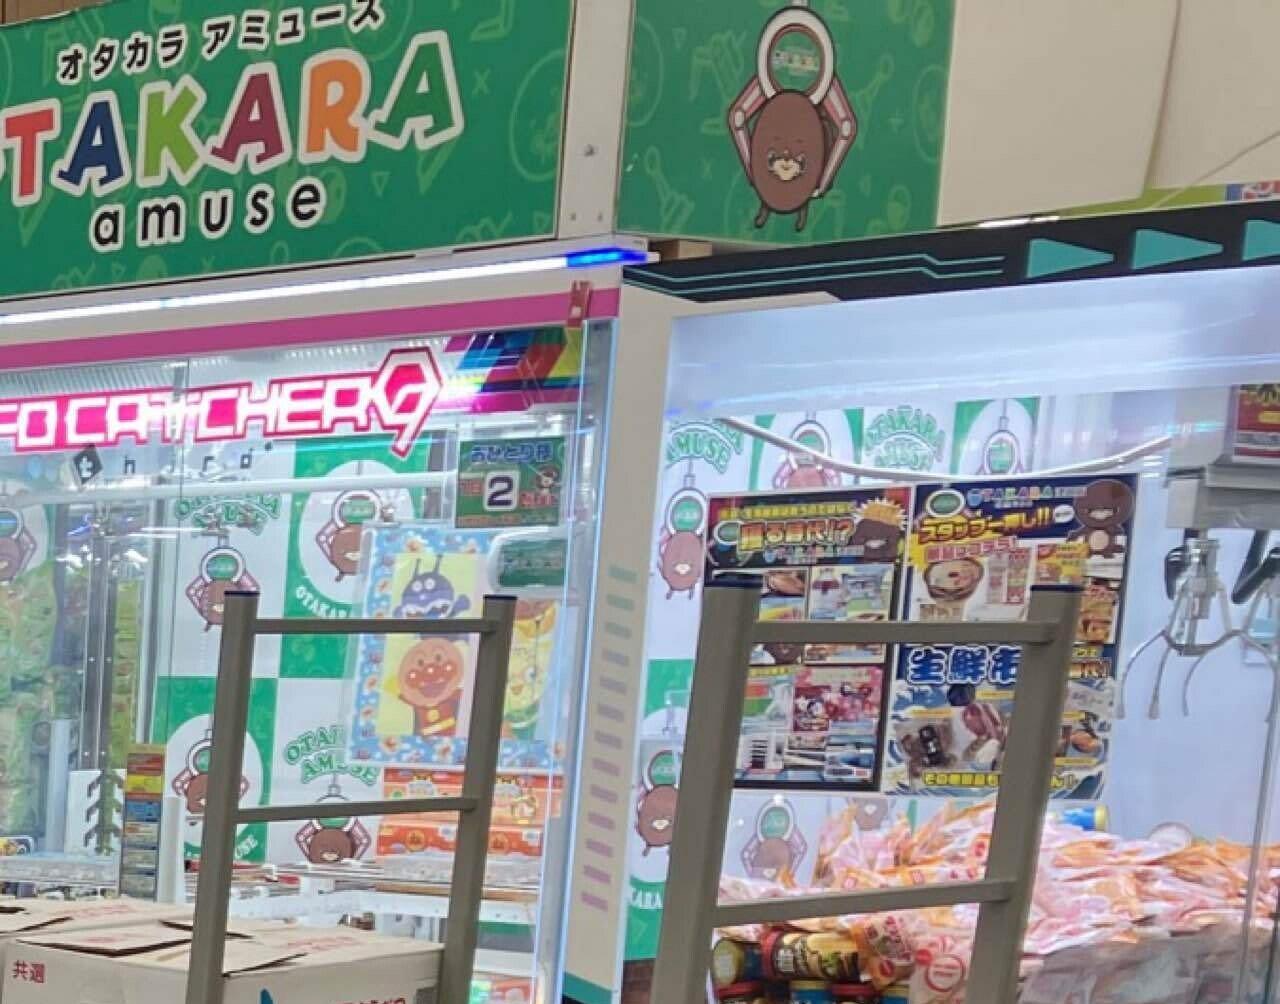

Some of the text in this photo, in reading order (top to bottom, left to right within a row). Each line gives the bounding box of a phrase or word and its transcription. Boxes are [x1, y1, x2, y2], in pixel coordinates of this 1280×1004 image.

[58, 0, 383, 80] オタカラ アミューズ
[94, 182, 322, 248] amuse
[64, 370, 380, 446] CATCHER
[486, 476, 513, 507] 2
